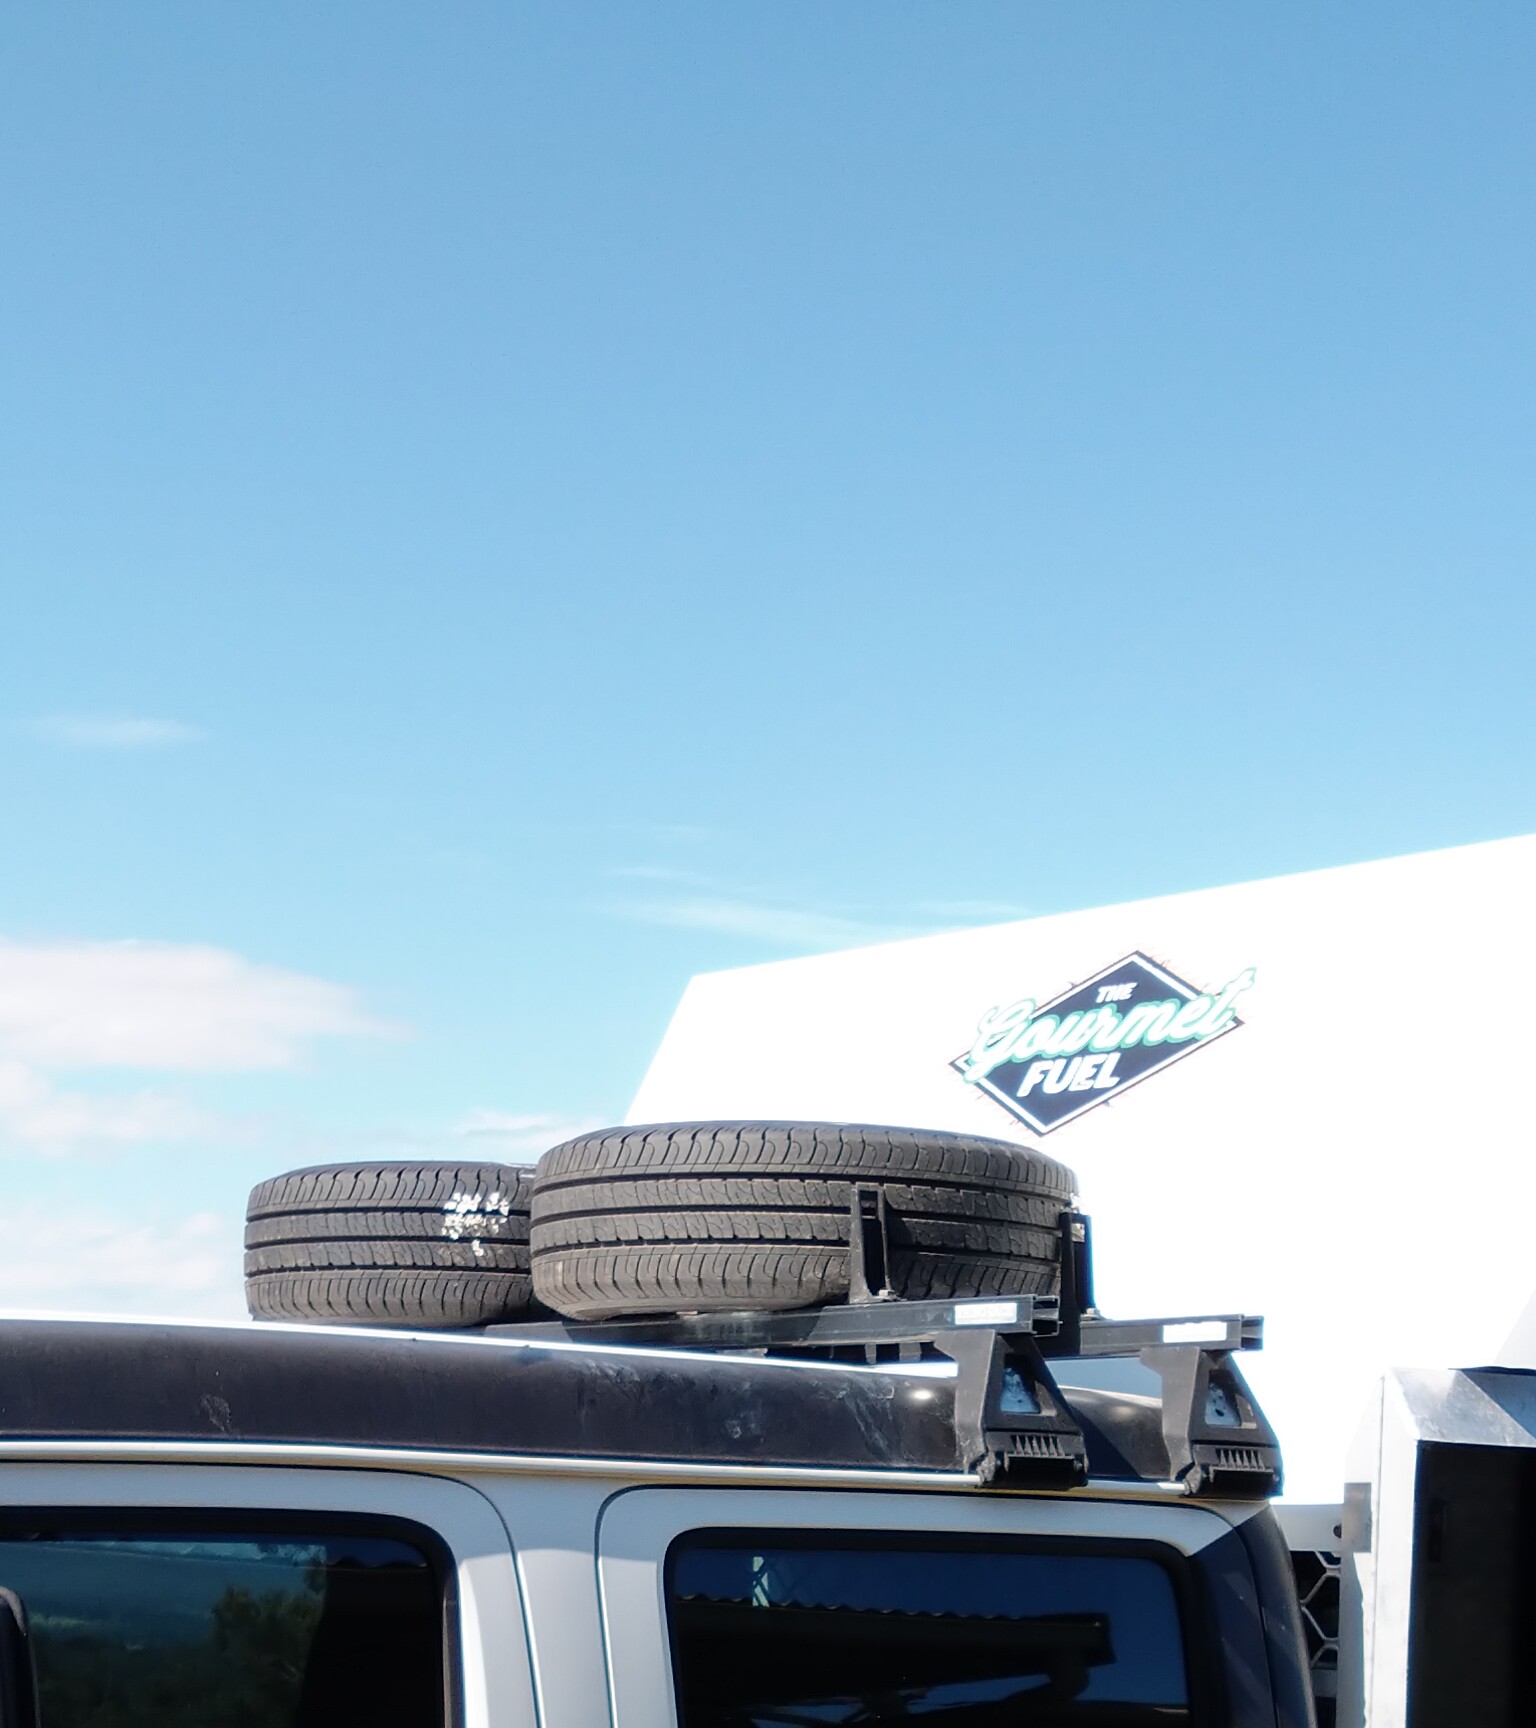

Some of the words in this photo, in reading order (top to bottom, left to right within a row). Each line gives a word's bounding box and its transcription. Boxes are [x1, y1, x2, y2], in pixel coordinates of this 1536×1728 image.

[1097, 983, 1137, 1003] THE
[966, 968, 1256, 1082] Gourmet
[1017, 1052, 1121, 1097] FUEL
